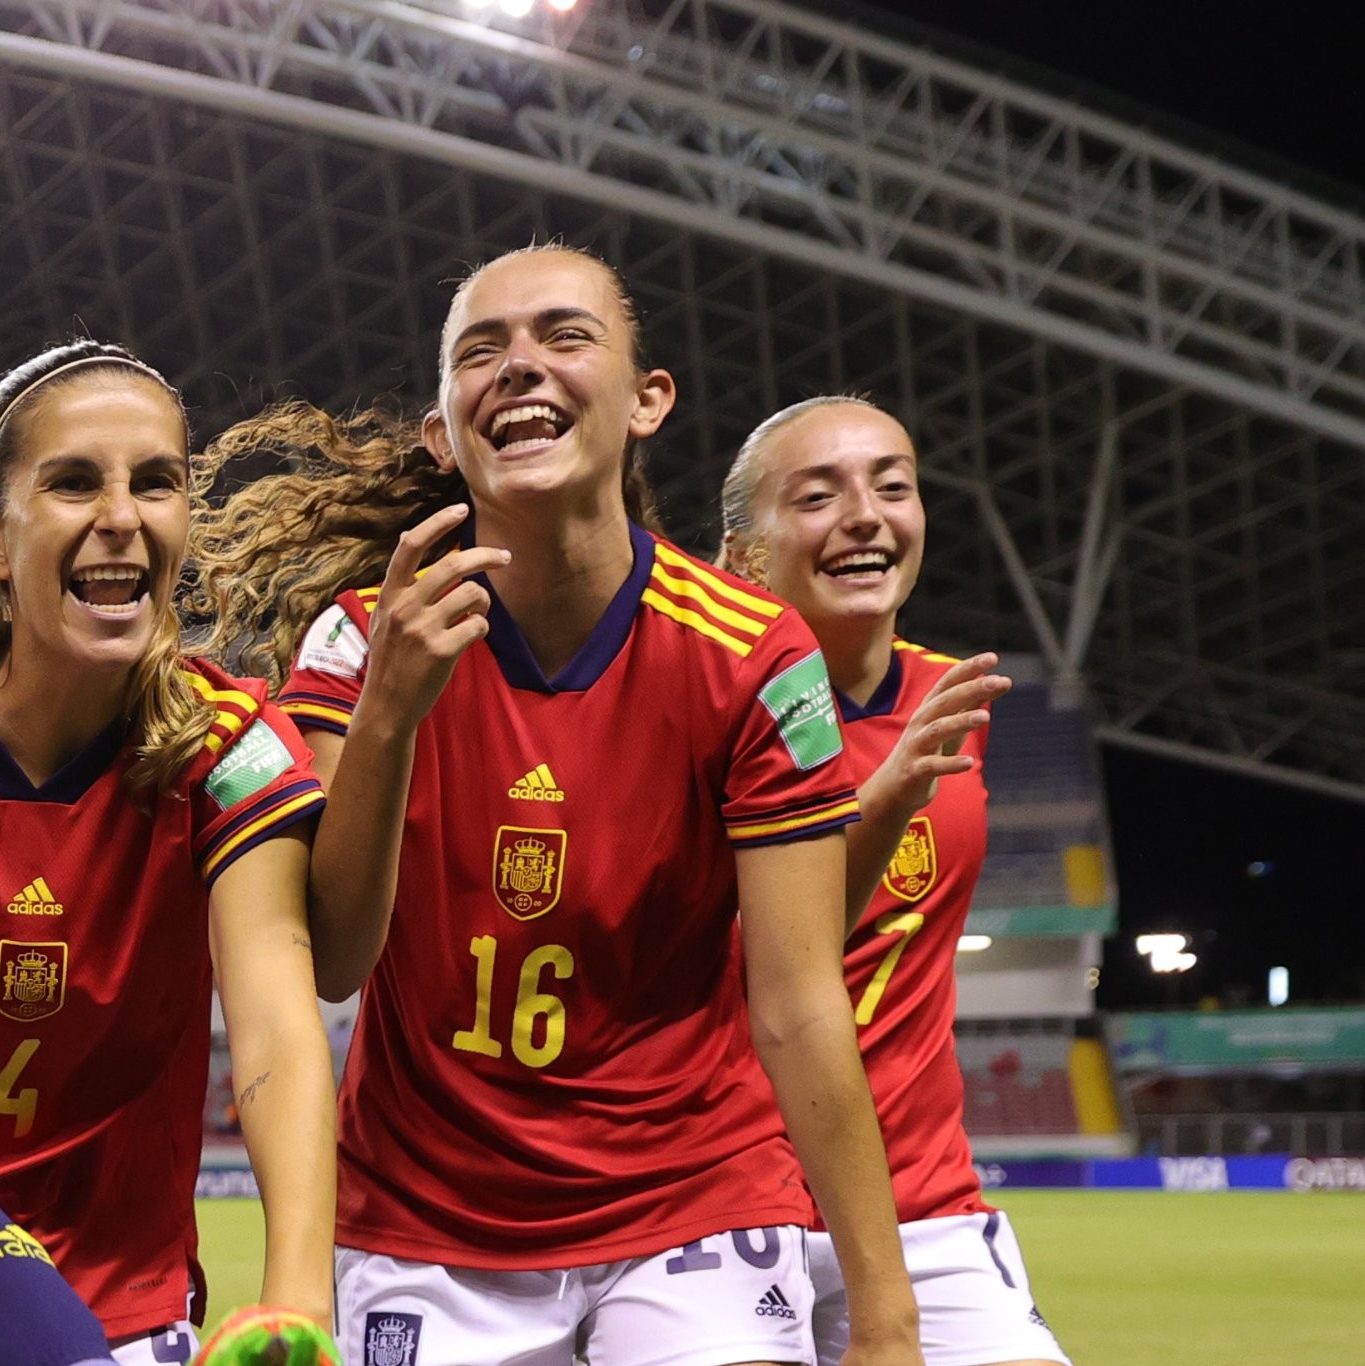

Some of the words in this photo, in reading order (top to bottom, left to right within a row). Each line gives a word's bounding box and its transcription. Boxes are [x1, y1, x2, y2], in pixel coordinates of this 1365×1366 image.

[507, 786, 565, 803] adidas
[6, 901, 65, 916] adidas
[855, 912, 925, 1025] 7
[451, 934, 575, 1069] 16
[755, 1303, 797, 1321] adidas
